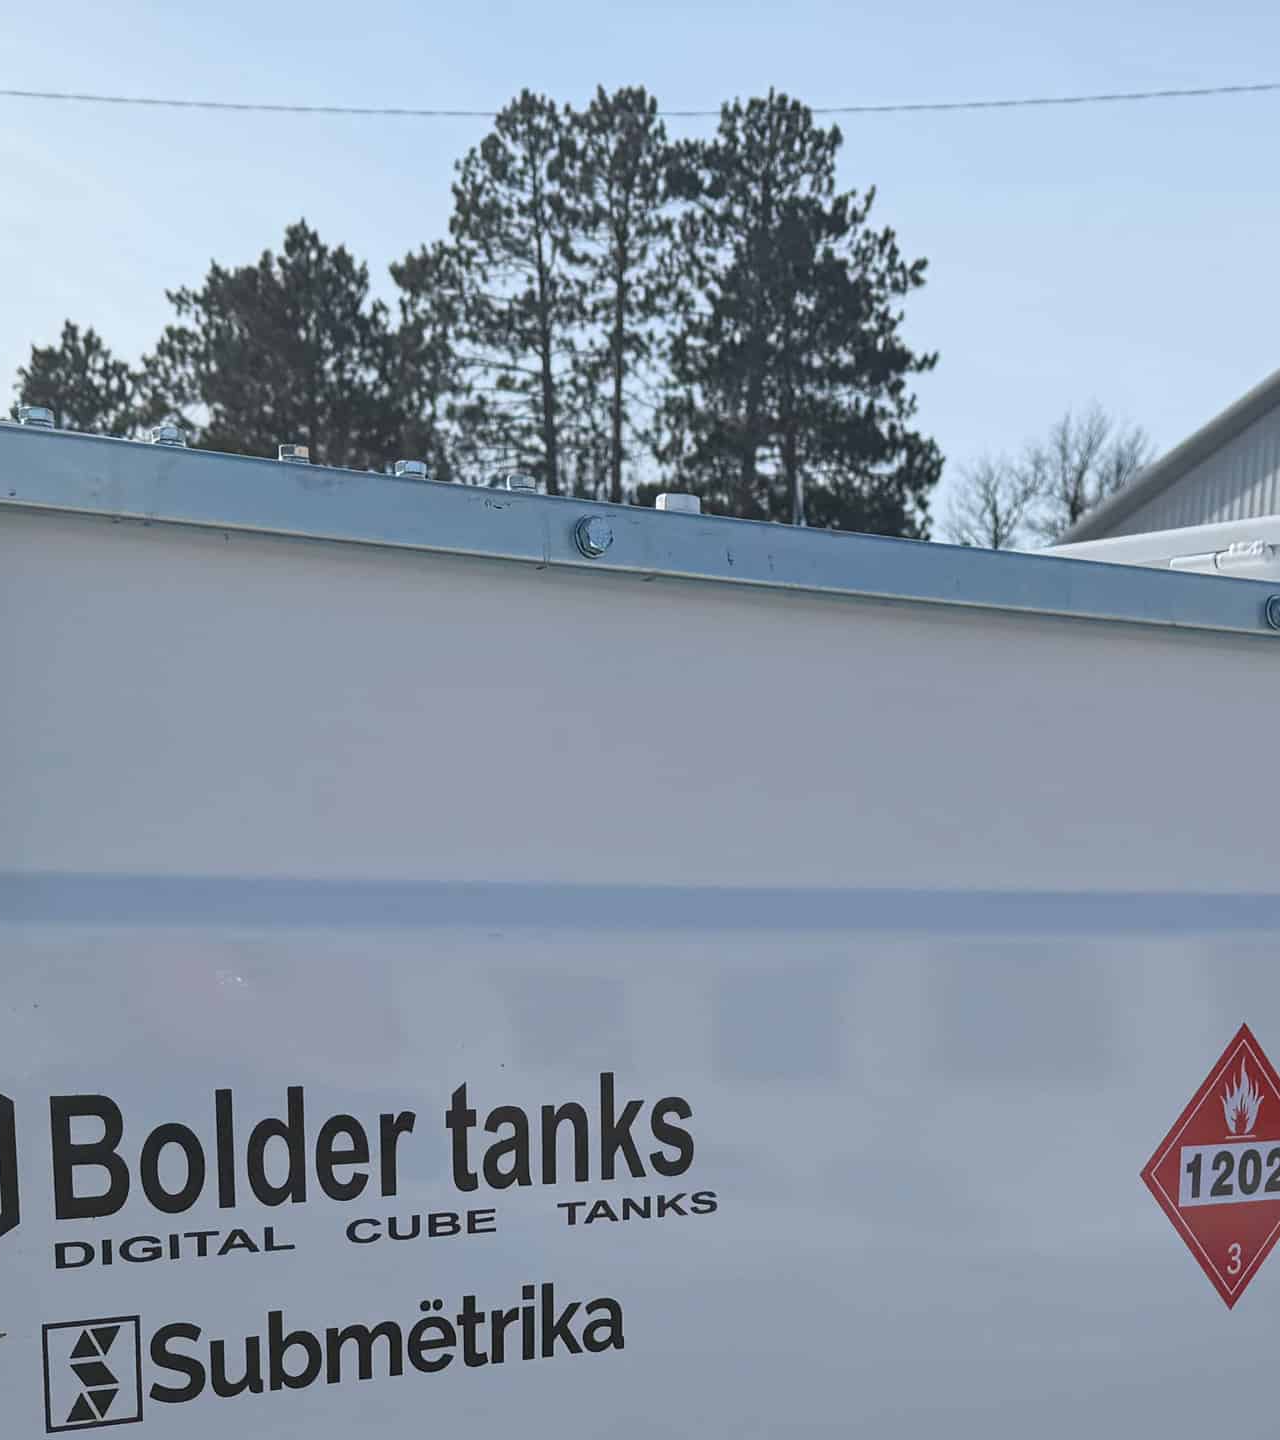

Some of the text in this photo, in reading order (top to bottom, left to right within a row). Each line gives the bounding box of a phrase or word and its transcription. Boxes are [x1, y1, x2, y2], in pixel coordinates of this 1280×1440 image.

[50, 1072, 693, 1220] Bolder tanks
[54, 1191, 718, 1269] DIGITAL CUBE TANKS
[1226, 1242, 1242, 1275] 3
[149, 1283, 624, 1403] Submëtrika
